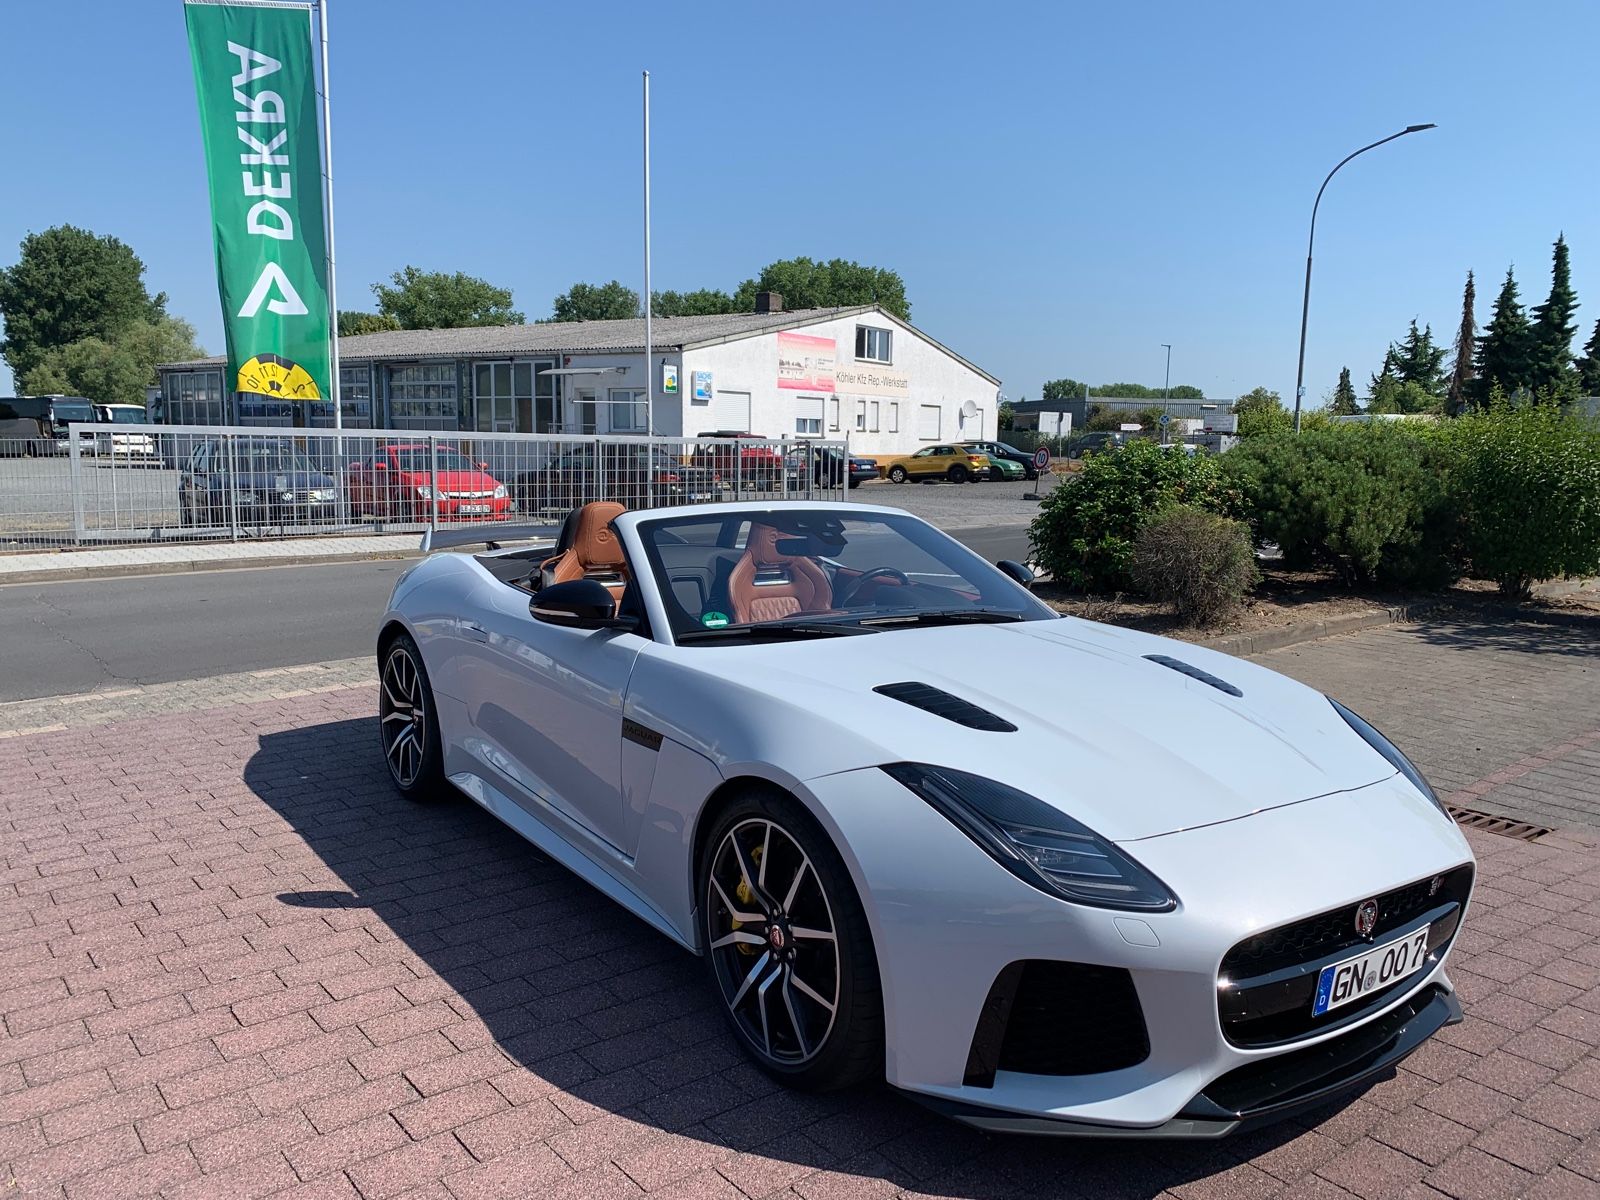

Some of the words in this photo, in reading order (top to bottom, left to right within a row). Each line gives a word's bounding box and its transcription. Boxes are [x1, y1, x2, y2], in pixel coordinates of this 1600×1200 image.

[836, 371, 856, 384] Köhler
[857, 373, 867, 385] Kfz
[868, 374, 908, 389] Rep.-Werkstatt
[1037, 453, 1046, 464] 10
[1332, 959, 1369, 1003] GN
